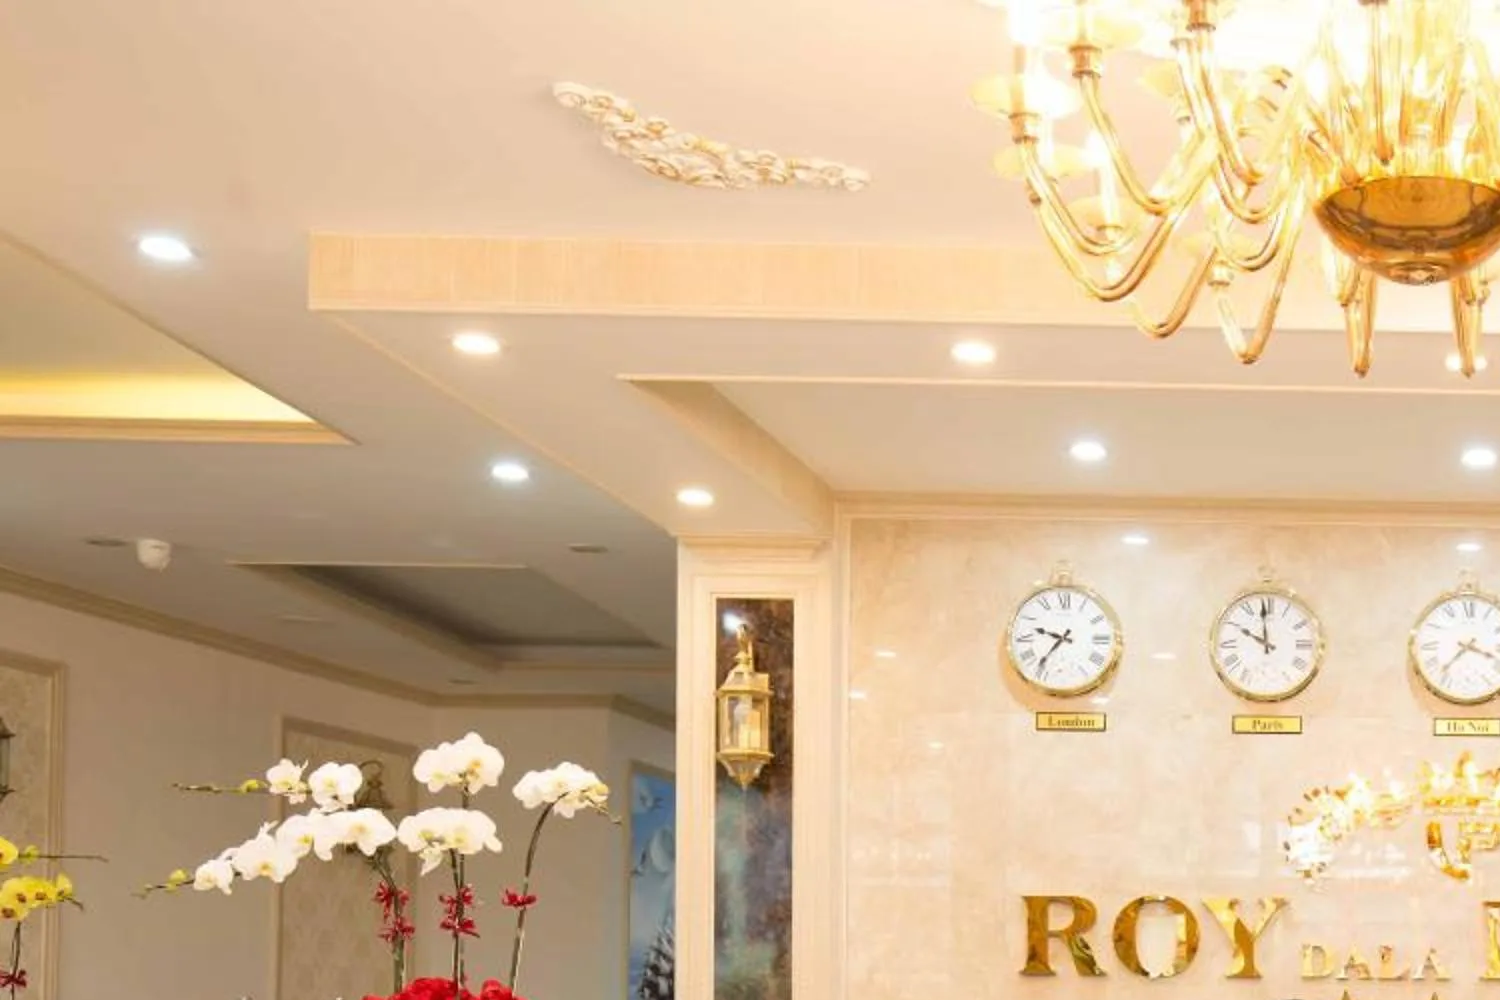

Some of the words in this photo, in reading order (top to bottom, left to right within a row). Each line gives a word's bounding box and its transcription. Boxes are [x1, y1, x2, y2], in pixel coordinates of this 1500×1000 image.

[1047, 715, 1096, 727] London
[1251, 719, 1284, 730] Paris
[1018, 895, 1290, 979] ROY
[1300, 944, 1452, 981] DALA
